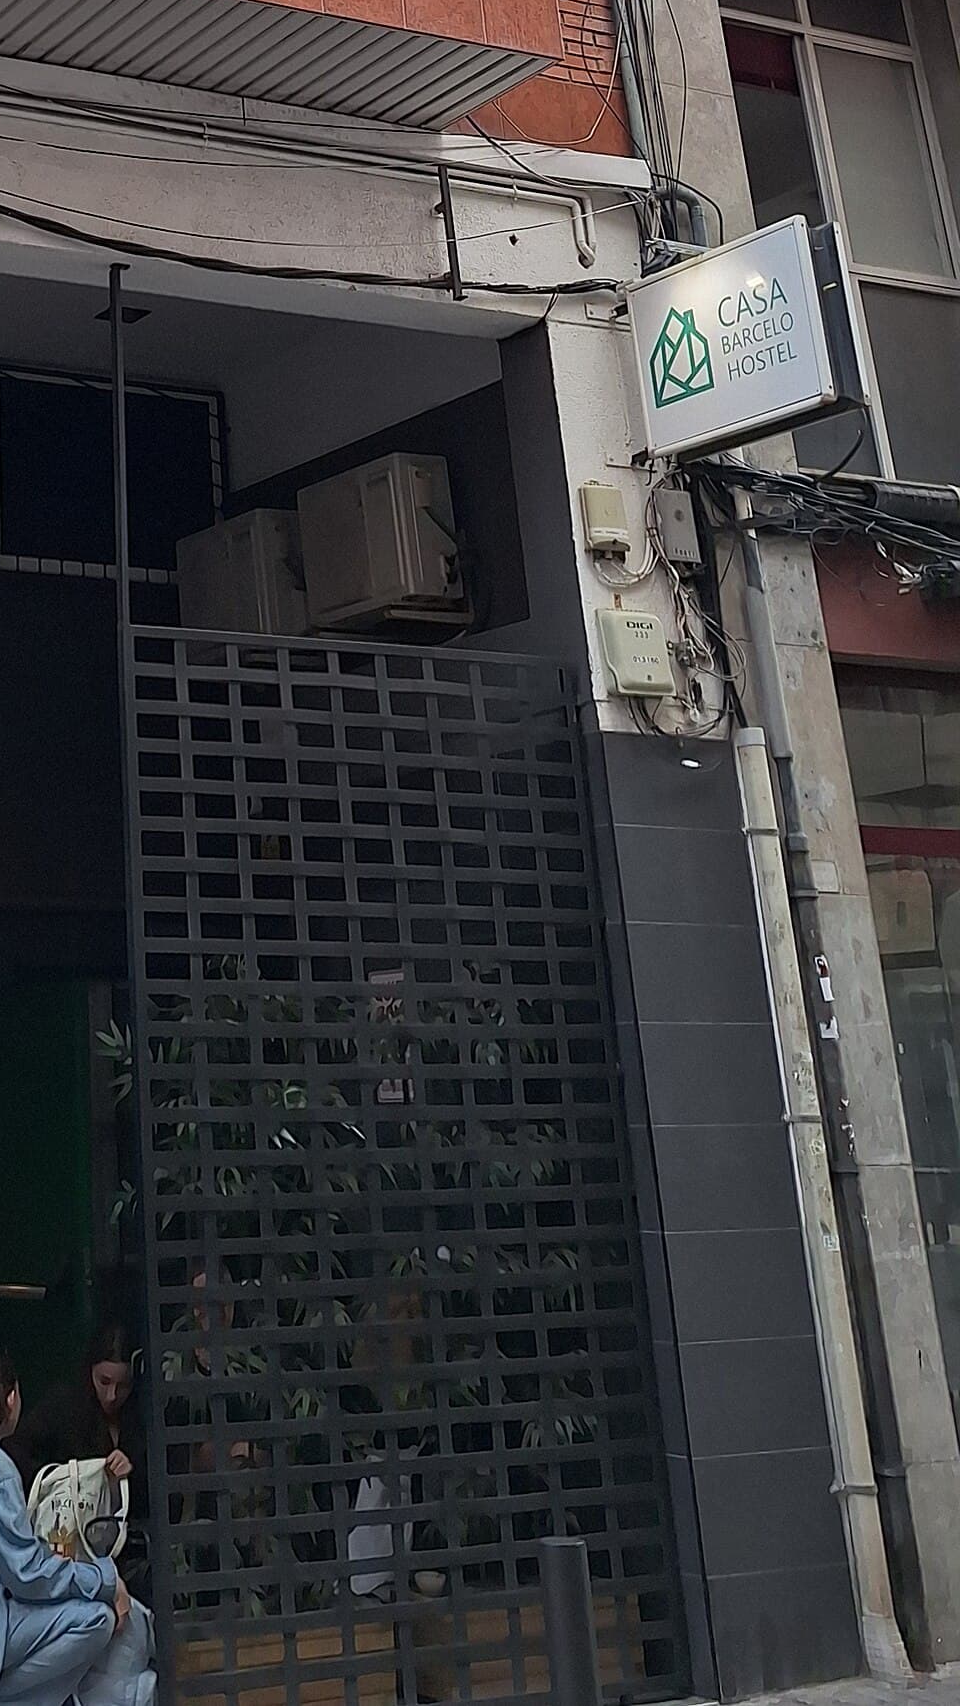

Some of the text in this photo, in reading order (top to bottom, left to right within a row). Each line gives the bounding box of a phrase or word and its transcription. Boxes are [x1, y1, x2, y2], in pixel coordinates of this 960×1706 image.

[718, 277, 788, 327] CASA
[721, 312, 794, 355] BARCELO
[727, 340, 798, 382] HOSTEL
[626, 621, 653, 630] DIGI
